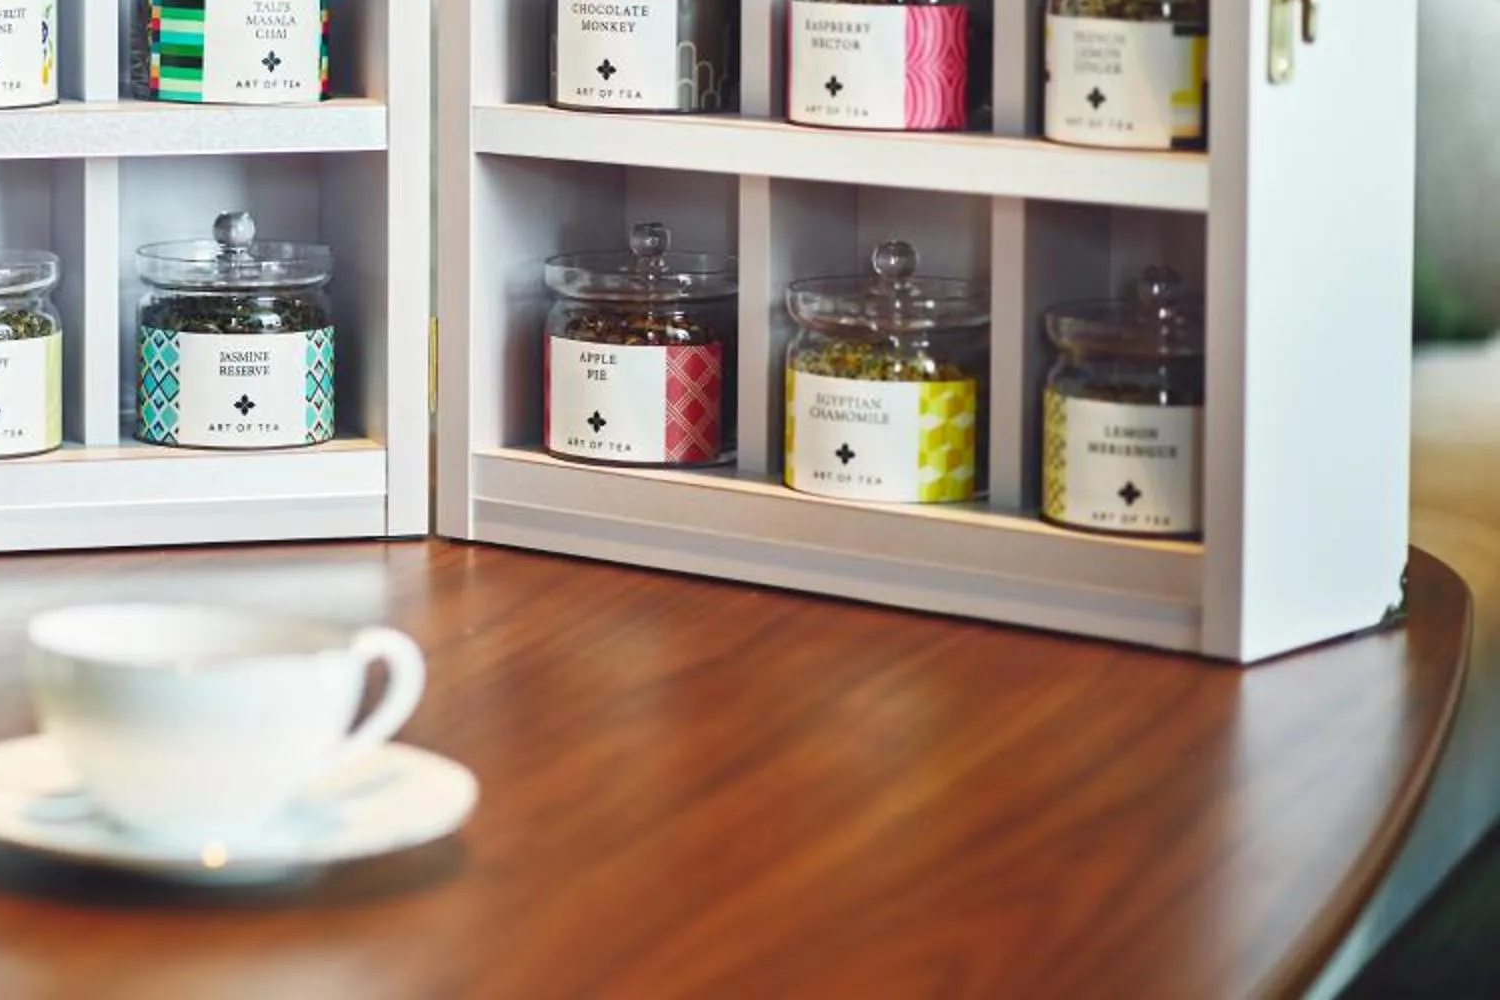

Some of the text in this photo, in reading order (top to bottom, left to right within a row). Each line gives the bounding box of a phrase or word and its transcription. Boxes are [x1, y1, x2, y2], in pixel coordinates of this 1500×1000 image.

[571, 3, 649, 17] CHOCOLATE
[246, 15, 297, 26] MASALA
[581, 20, 637, 33] MONKEY
[255, 28, 287, 40] CHAI
[2, 81, 22, 90] TEA
[236, 80, 301, 89] ART OF TEA
[576, 87, 642, 99] ART OF TEA
[220, 351, 270, 363] JASMINE
[579, 351, 617, 365] APPLE
[219, 365, 271, 377] RESERVE
[587, 369, 608, 381] PIE
[816, 392, 882, 409] EGYPTIAN
[809, 407, 890, 425] CHAMOMILE
[2, 428, 23, 437] TEA
[208, 423, 280, 432] ART OF TEA
[567, 437, 631, 452] ART OF TEA
